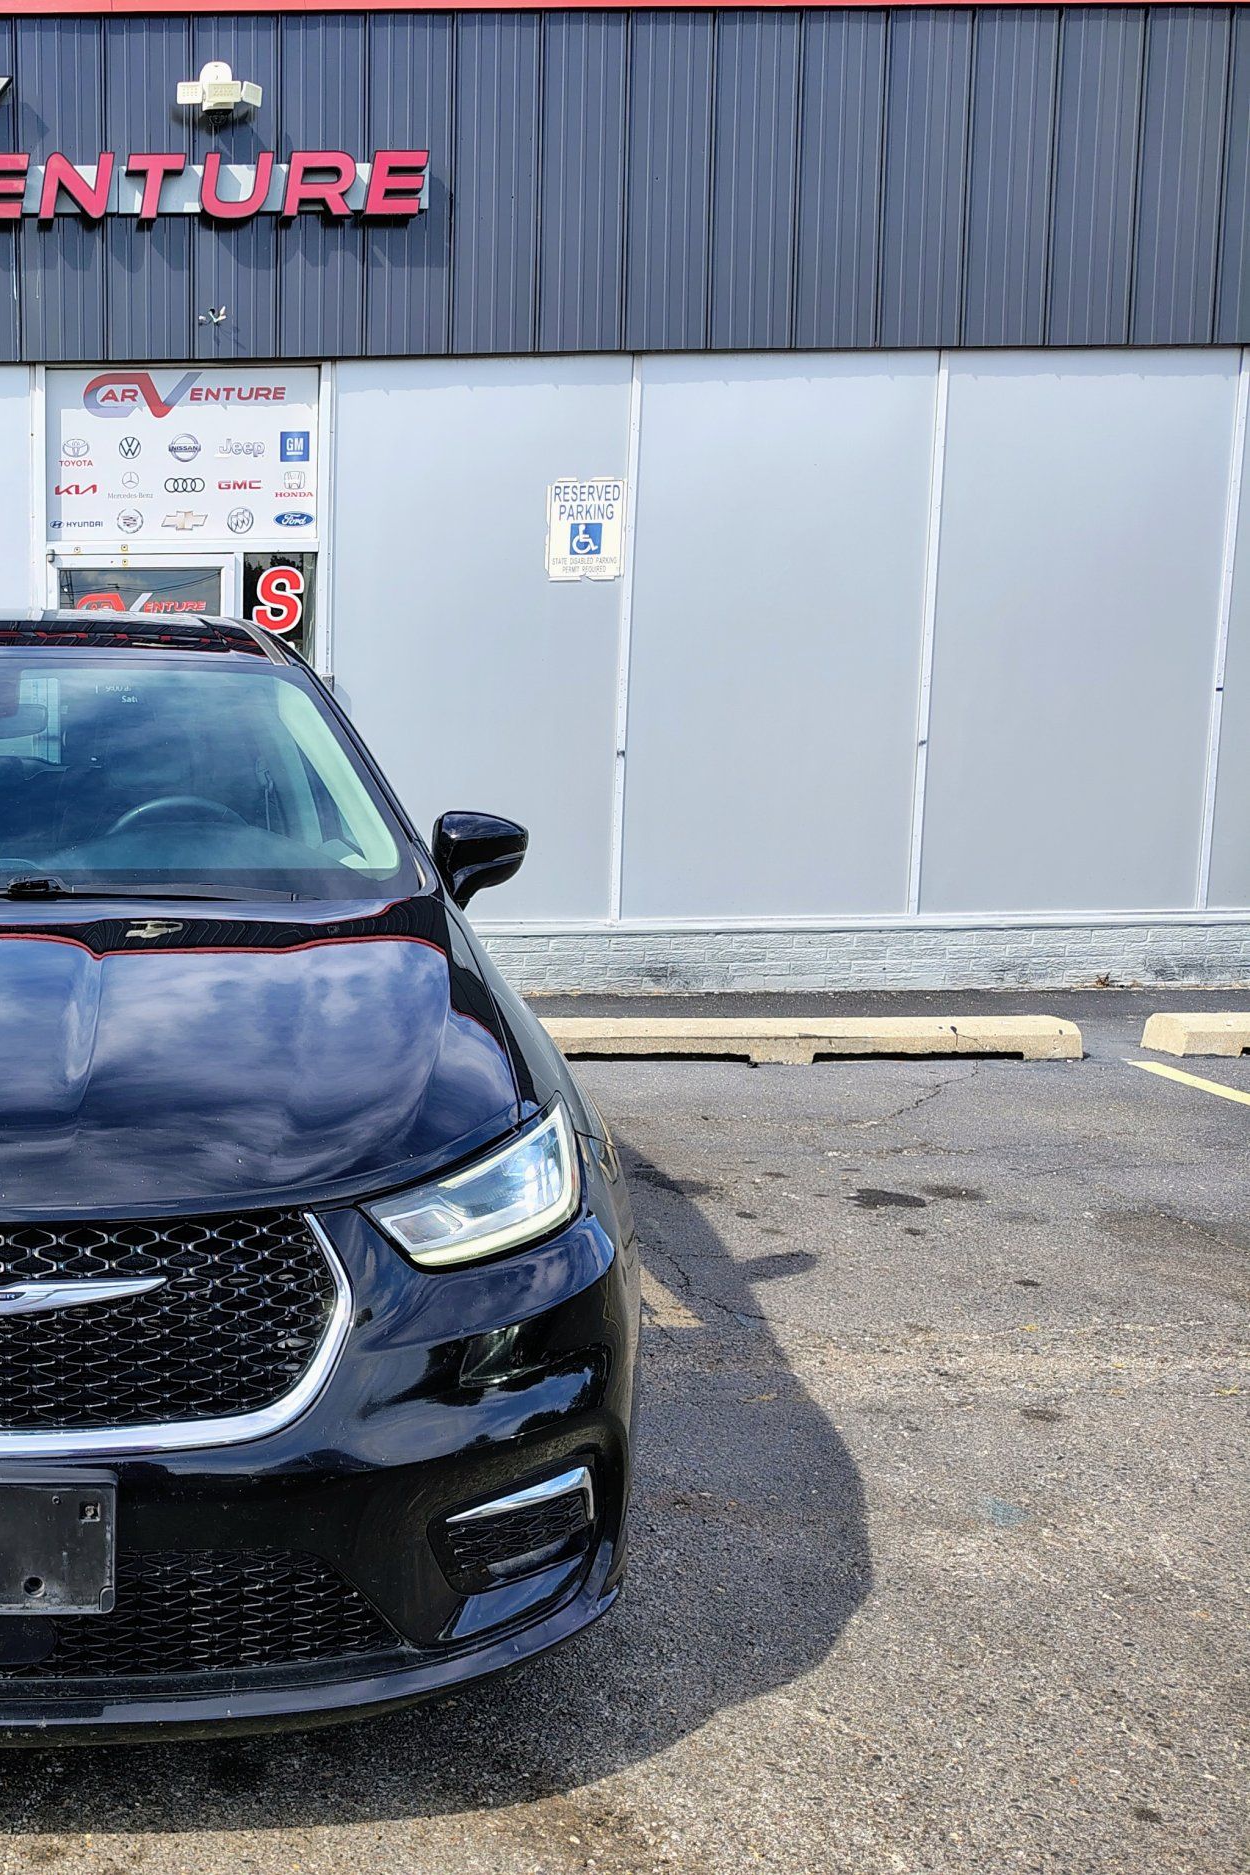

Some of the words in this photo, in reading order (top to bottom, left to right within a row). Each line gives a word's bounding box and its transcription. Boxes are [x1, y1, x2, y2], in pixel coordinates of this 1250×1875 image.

[218, 438, 266, 457] Jeep
[286, 437, 304, 451] GM
[54, 484, 97, 495] KIA
[217, 480, 262, 490] GMC
[554, 484, 621, 502] RESERVED
[281, 513, 307, 525] Ford
[558, 503, 615, 521] PARKING
[66, 520, 104, 528] HYUNDAI
[252, 566, 304, 635] S
